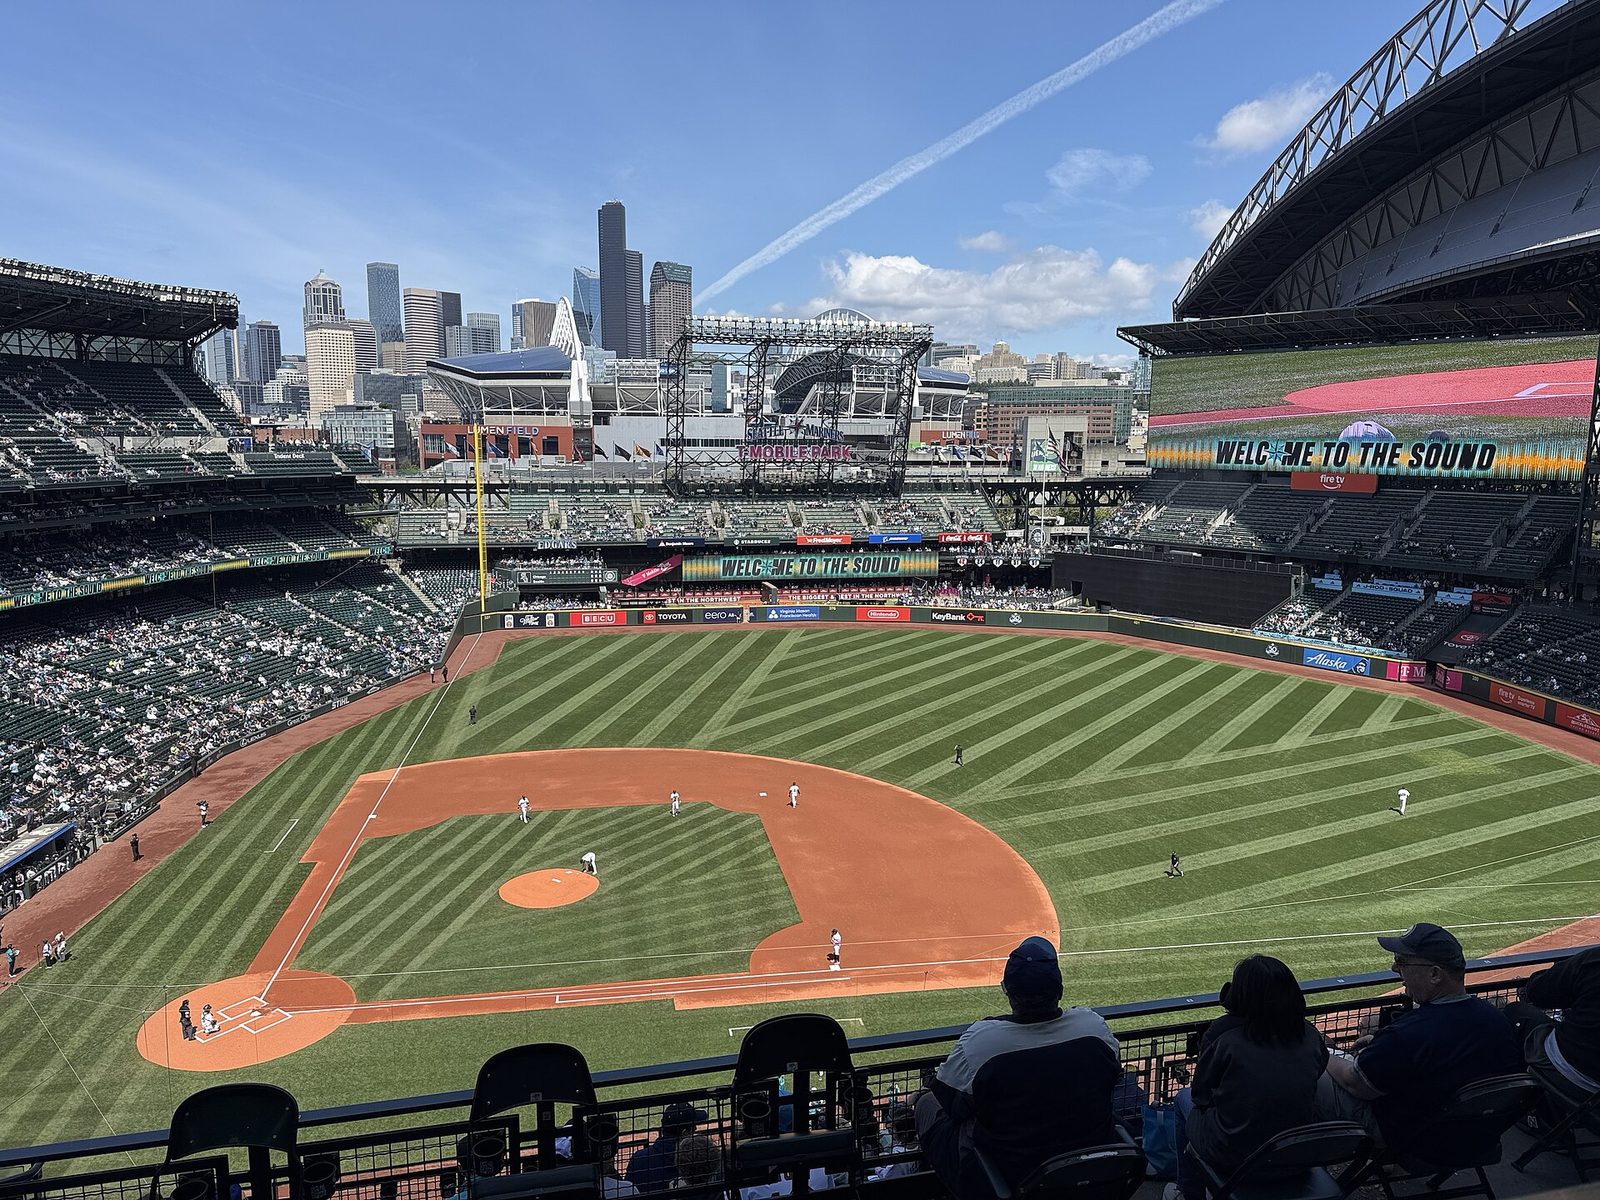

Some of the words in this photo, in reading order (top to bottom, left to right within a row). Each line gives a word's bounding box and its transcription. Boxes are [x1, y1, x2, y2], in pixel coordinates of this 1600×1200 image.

[505, 426, 540, 436] FIELD
[746, 425, 784, 440] SEATTLE
[805, 424, 844, 442] MARINERS
[942, 431, 966, 439] LUMEN
[735, 444, 808, 460] T-MOBILE
[811, 444, 852, 460] PARK
[1216, 439, 1316, 466] WELCME
[1322, 441, 1350, 468] TO
[1360, 442, 1403, 468] THE
[1408, 443, 1497, 470] SOUND
[1320, 474, 1334, 483] fire
[1336, 474, 1345, 483] tv
[283, 554, 292, 563] TO
[294, 553, 306, 562] THE
[308, 552, 329, 562] SOUND
[721, 558, 794, 577] WELCME
[799, 558, 817, 575] TO
[822, 558, 848, 574] THE
[852, 556, 901, 574] SOUND
[182, 567, 195, 578] THE
[52, 590, 62, 601] TO
[64, 587, 78, 598] THE
[79, 583, 102, 597] SOUND
[932, 612, 965, 621] KeyBank
[1306, 653, 1346, 670] Alaska
[1499, 688, 1508, 698] fire
